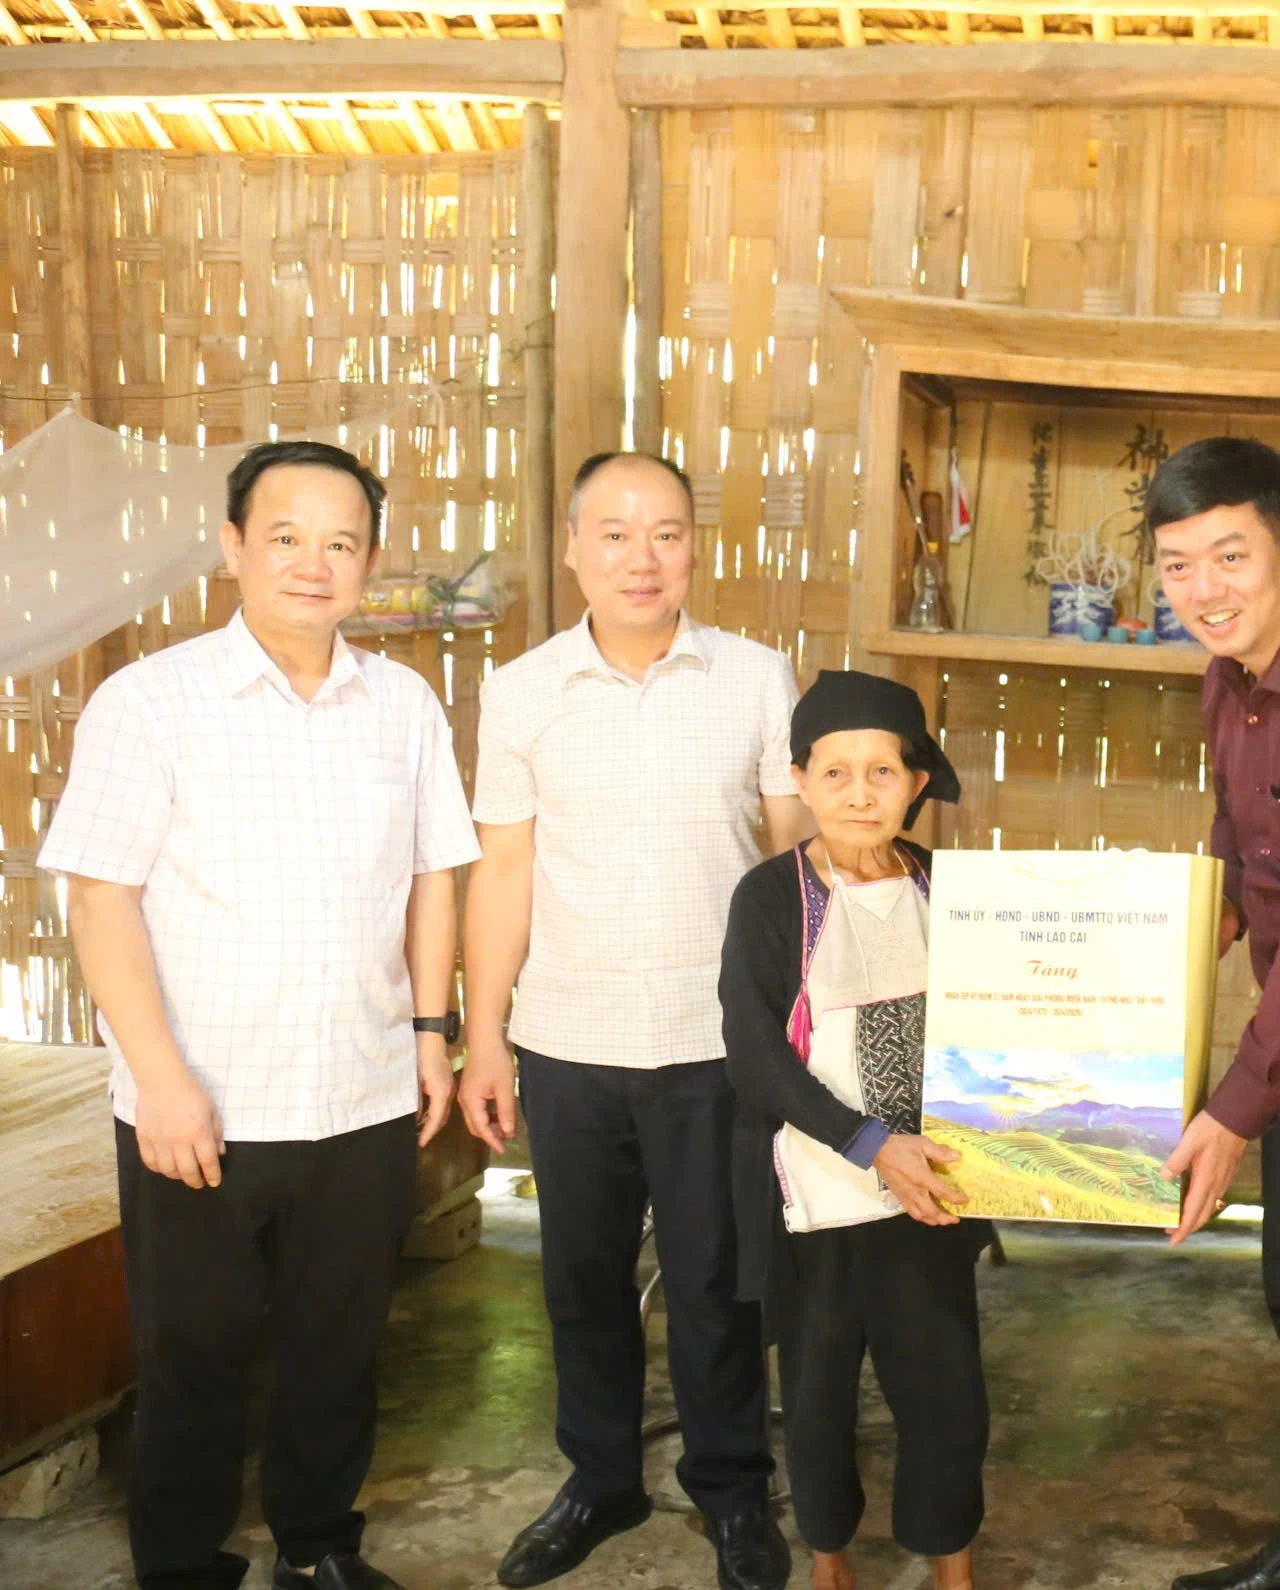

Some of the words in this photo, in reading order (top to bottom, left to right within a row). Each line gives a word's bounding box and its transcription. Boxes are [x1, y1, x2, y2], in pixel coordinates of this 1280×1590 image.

[1032, 911, 1060, 922] UBND
[1071, 911, 1114, 925] UBMTTQ
[1143, 912, 1168, 925] NAM
[1070, 931, 1087, 943] CAI
